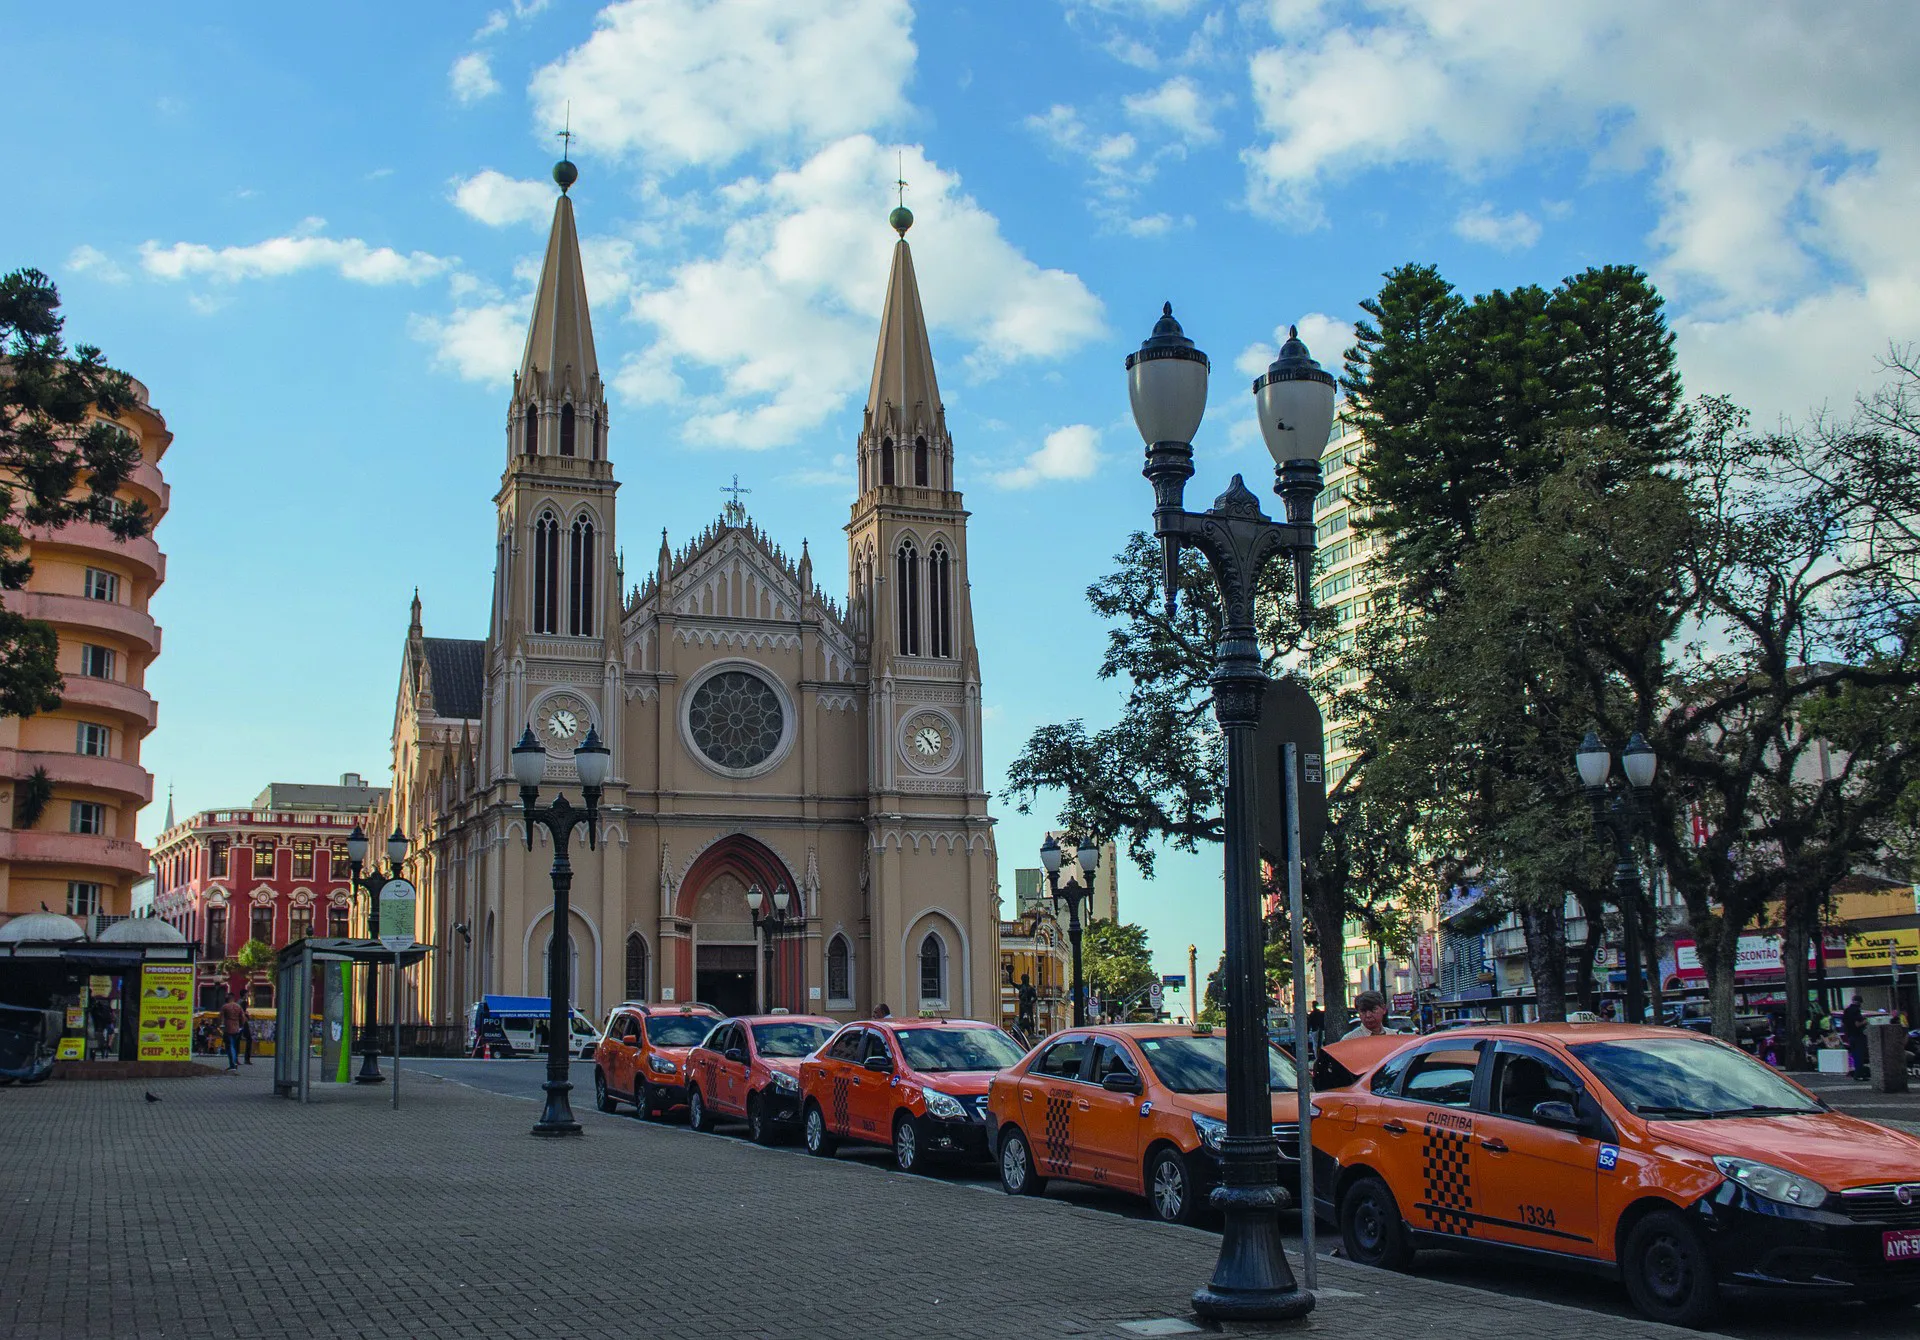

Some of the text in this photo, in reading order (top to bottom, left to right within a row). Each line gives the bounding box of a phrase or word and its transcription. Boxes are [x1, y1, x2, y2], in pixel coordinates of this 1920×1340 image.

[1867, 938, 1899, 947] GALERA
[1736, 948, 1778, 961] ESCONTÃO
[145, 966, 192, 974] PROMOÇÃO
[141, 1047, 164, 1056] CHIP
[1050, 1088, 1073, 1098] CURITIBA
[1426, 1111, 1473, 1130] CURITIBA
[1600, 1154, 1615, 1167] 156
[1517, 1204, 1556, 1228] 1334
[1887, 1239, 1920, 1256] AYR-9
